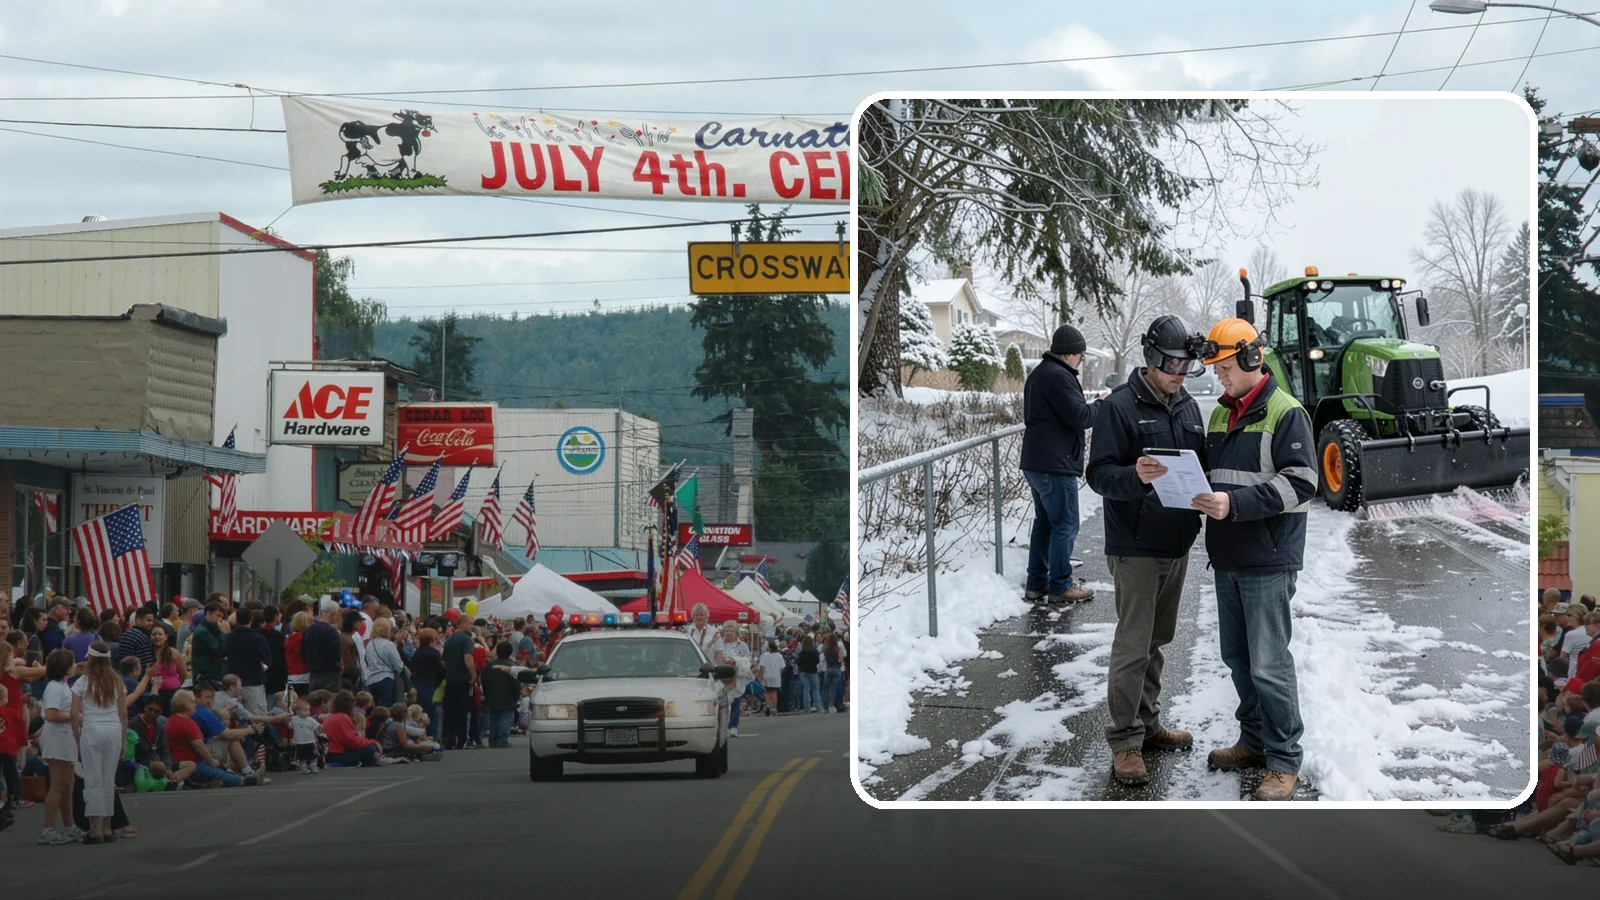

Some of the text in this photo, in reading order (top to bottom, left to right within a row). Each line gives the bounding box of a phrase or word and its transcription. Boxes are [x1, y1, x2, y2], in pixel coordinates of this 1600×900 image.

[695, 121, 850, 150] Carnat
[481, 141, 604, 192] JULY
[632, 150, 746, 197] 4th.
[697, 254, 850, 280] CROSSWA
[282, 380, 373, 420] ACE
[405, 409, 452, 422] CEDAR
[283, 421, 370, 436] Hardware
[416, 428, 476, 447] Coca-Cola
[95, 485, 124, 494] Vincent
[126, 486, 135, 495] de
[137, 486, 155, 495] Paul
[688, 526, 741, 535] CRNATION
[699, 535, 730, 543] GLASS
